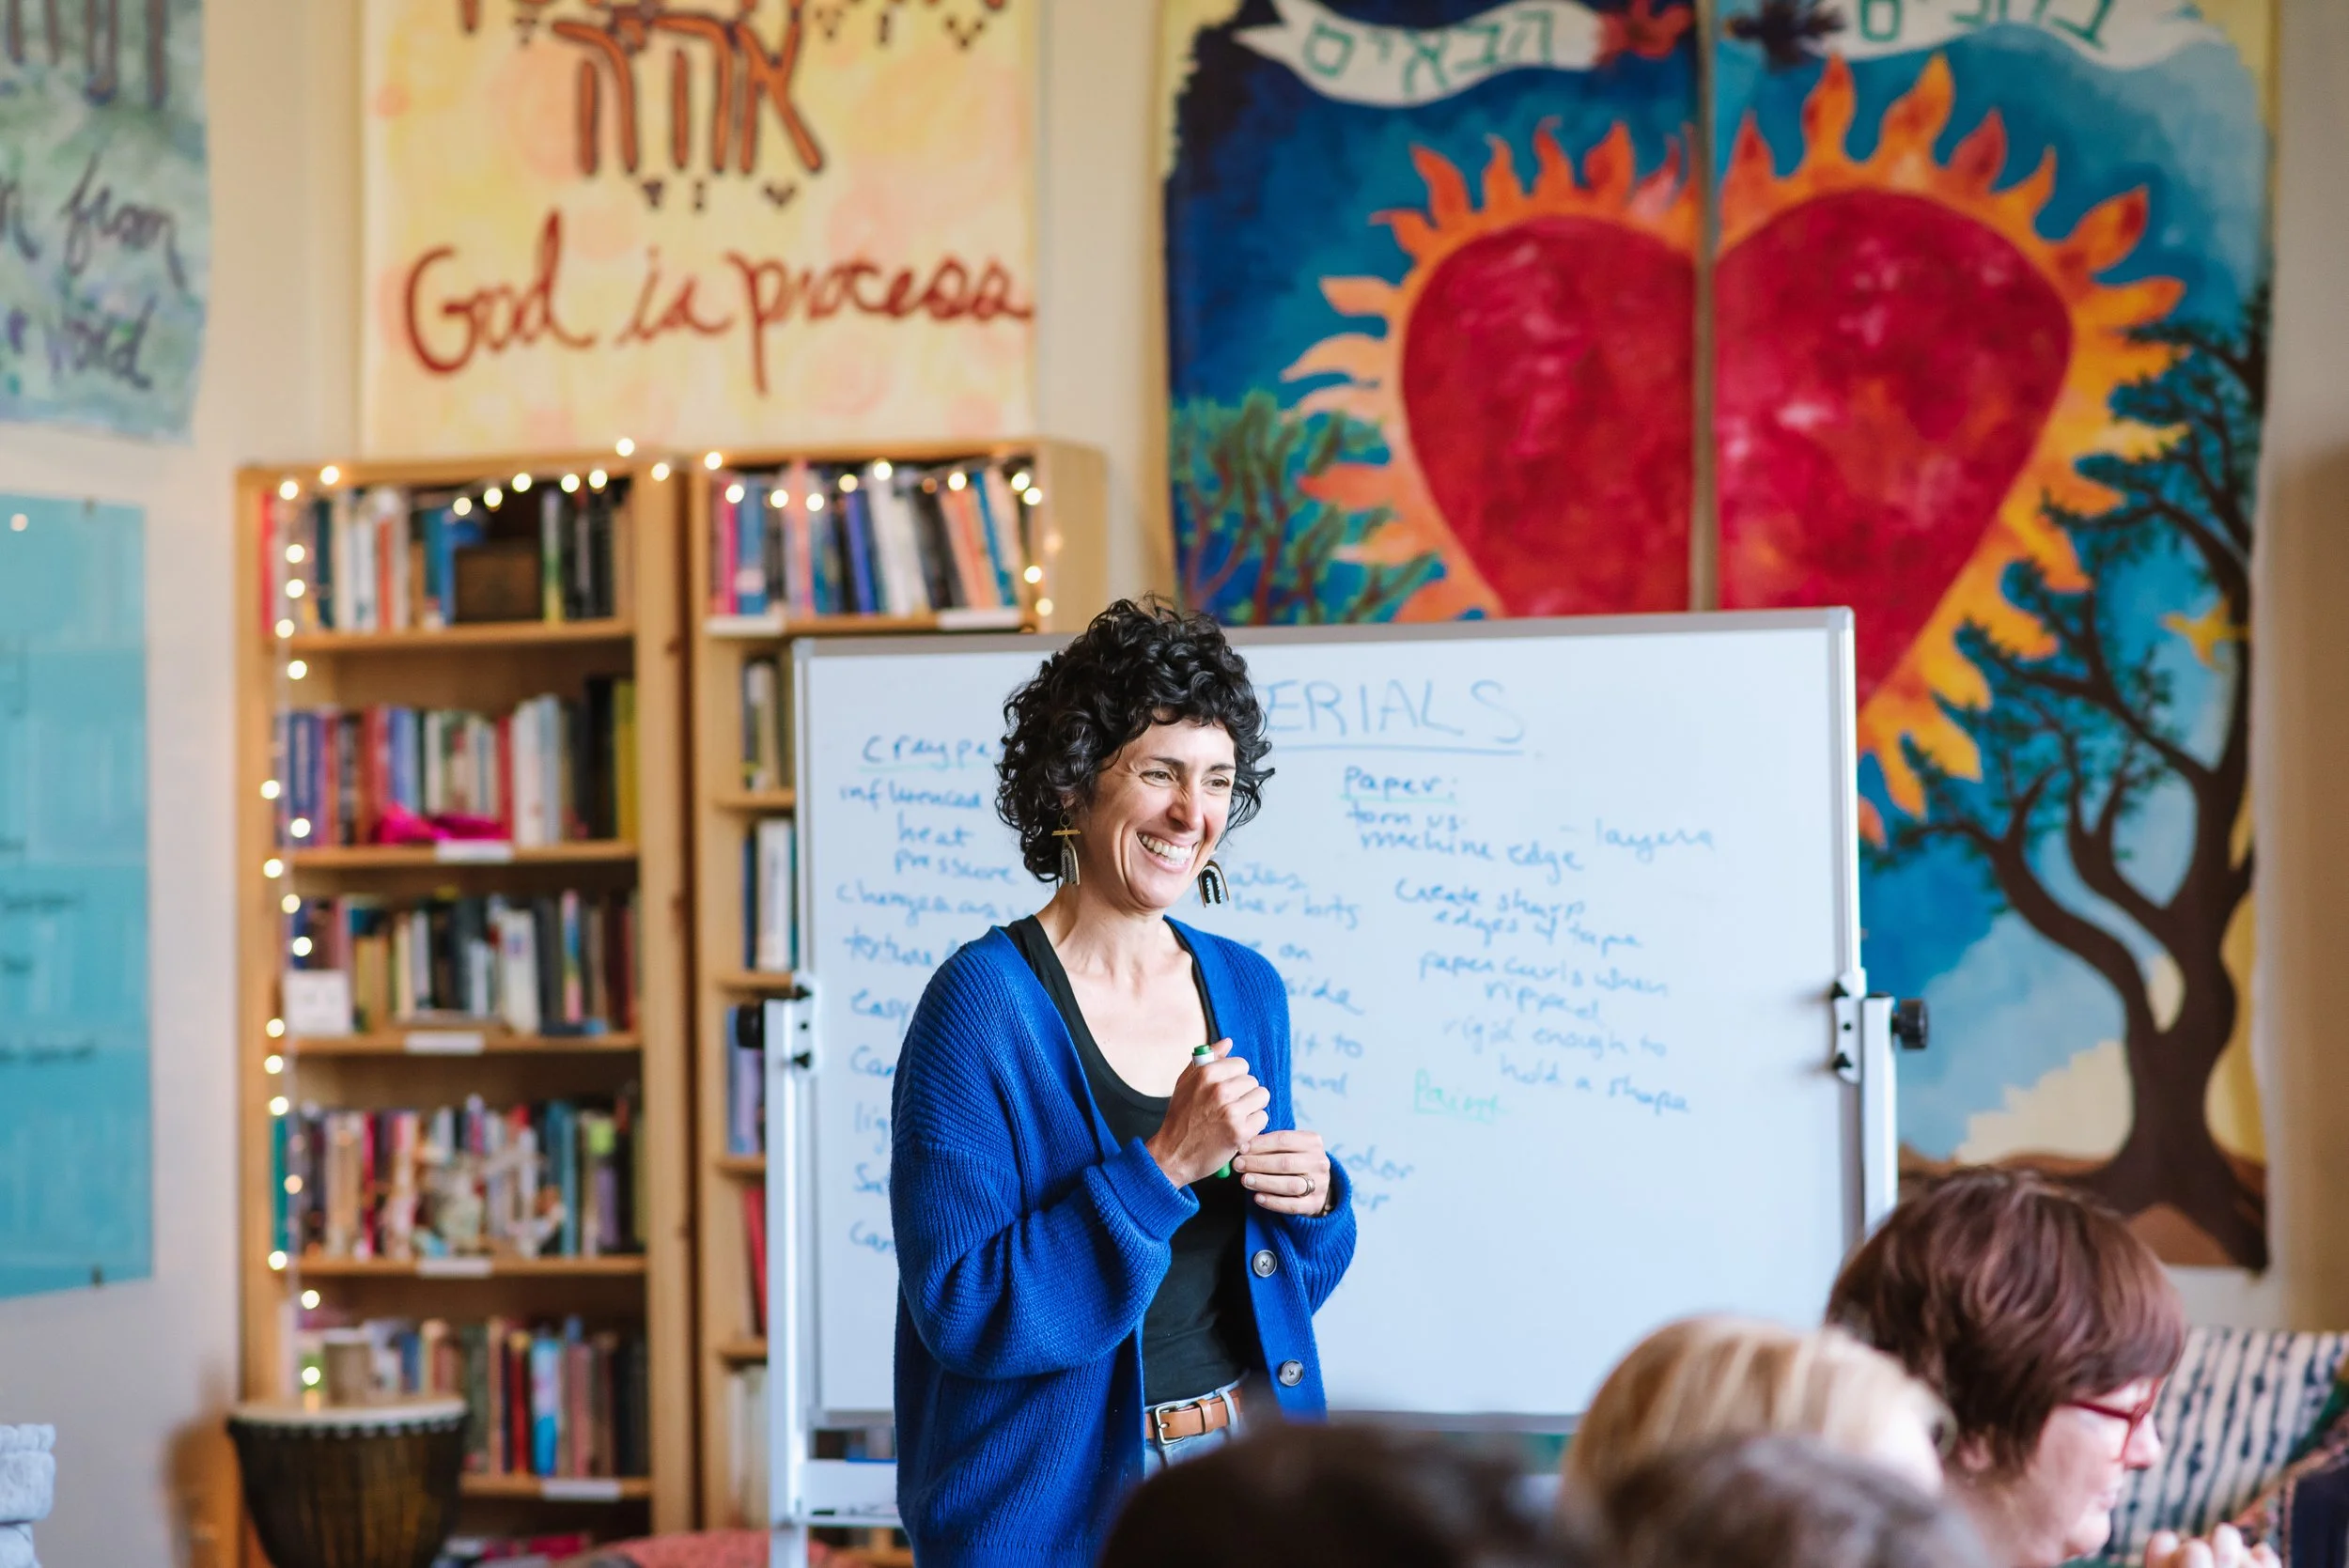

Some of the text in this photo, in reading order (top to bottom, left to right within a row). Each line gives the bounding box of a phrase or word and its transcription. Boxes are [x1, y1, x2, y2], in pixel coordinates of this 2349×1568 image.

[404, 207, 1036, 397] God is process
[1257, 678, 1526, 744] ERIALS
[896, 810, 973, 846] heat
[1360, 831, 1585, 886] machine edge
